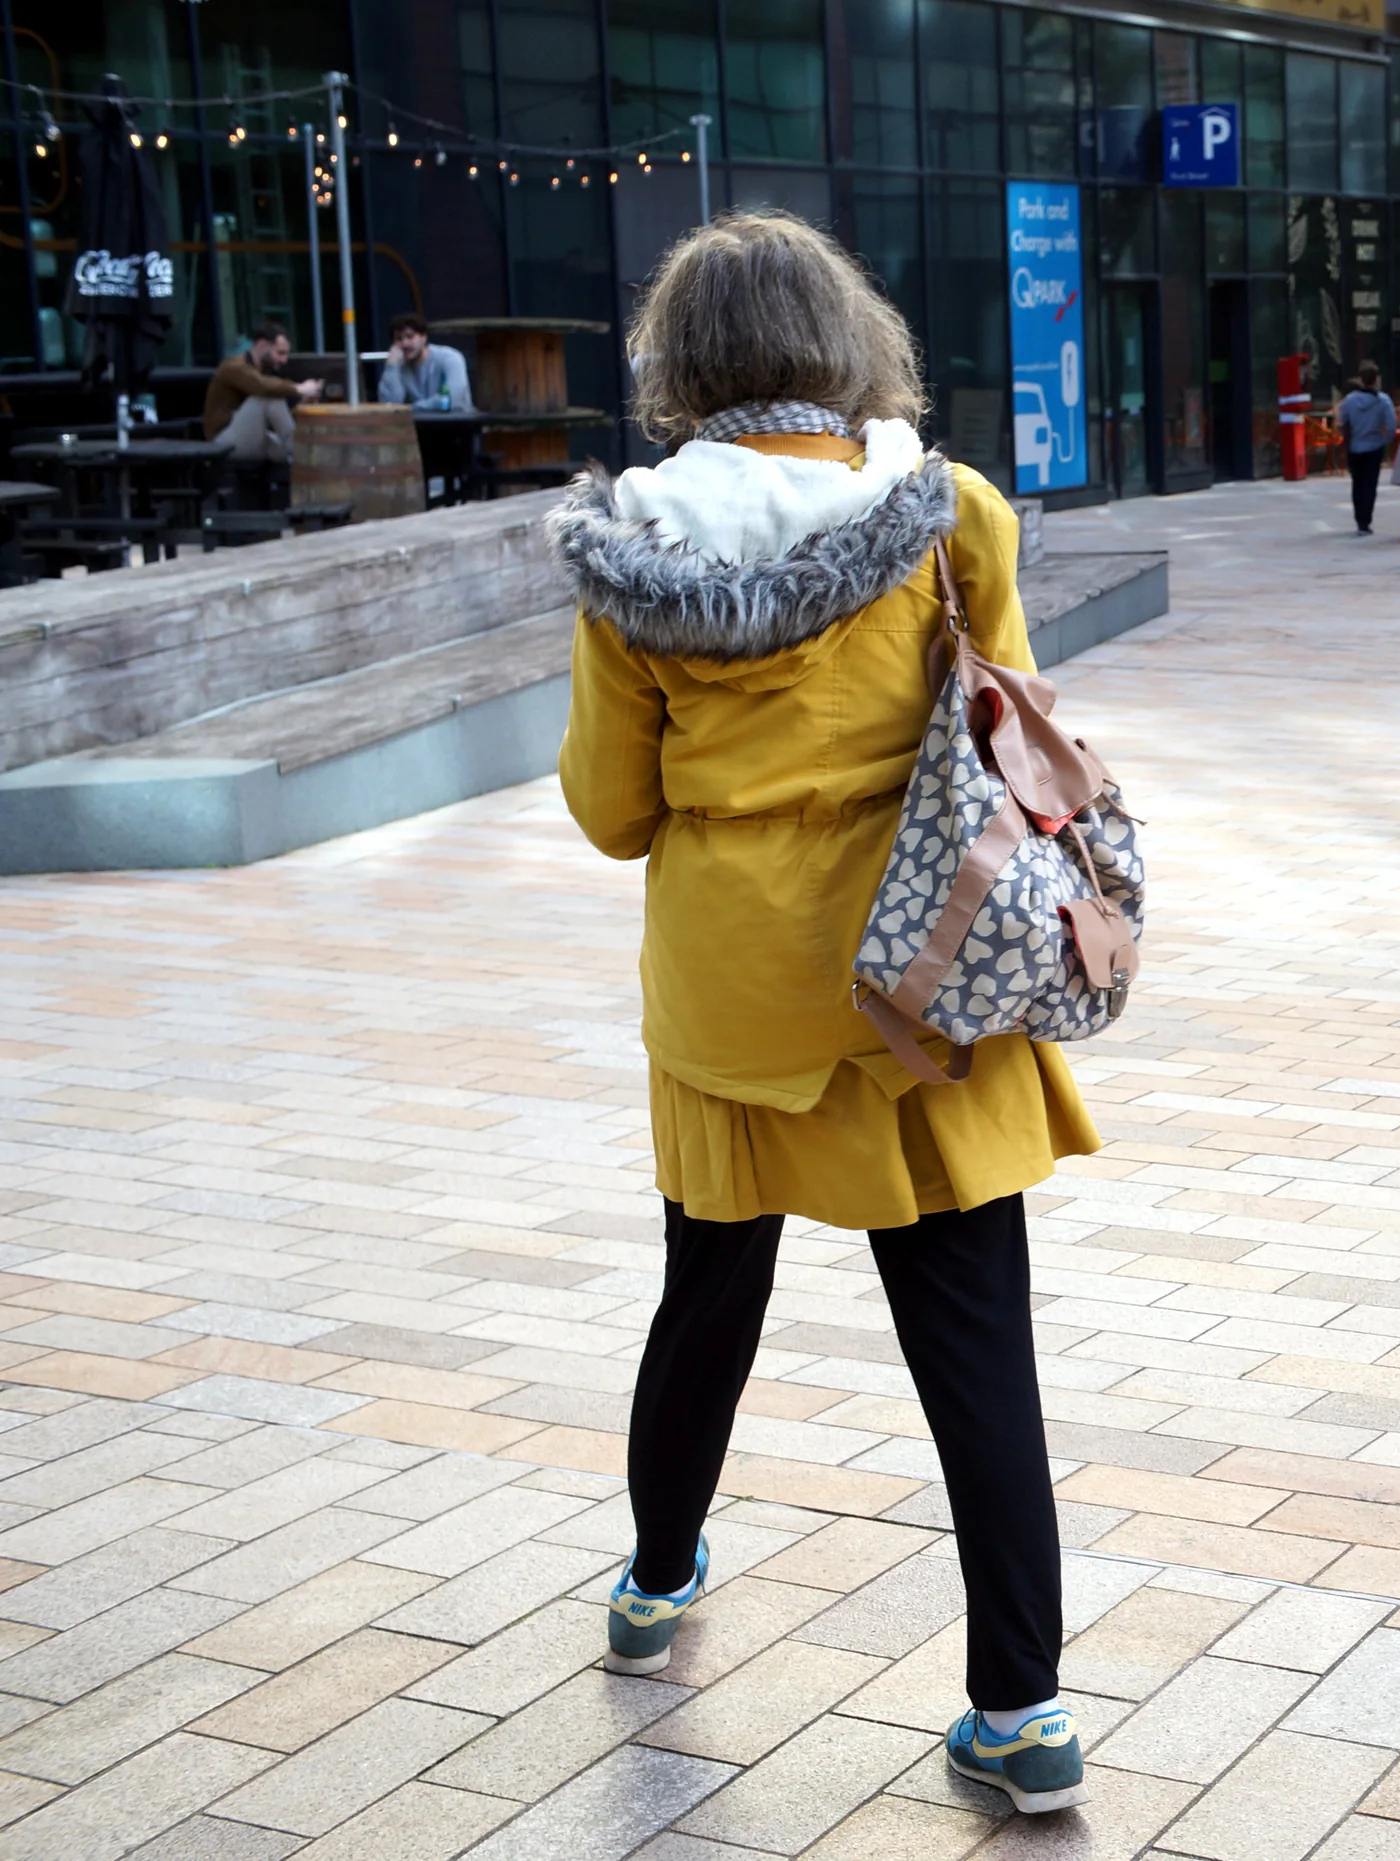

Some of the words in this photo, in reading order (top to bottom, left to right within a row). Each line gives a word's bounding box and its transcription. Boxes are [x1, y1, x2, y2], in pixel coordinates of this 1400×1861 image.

[1203, 115, 1232, 160] P
[1018, 197, 1044, 220] Park
[1047, 198, 1070, 220] and
[1010, 229, 1052, 258] Charge
[1054, 229, 1079, 252] with
[628, 1601, 657, 1618] NIKE
[1040, 1719, 1067, 1738] NIKE
